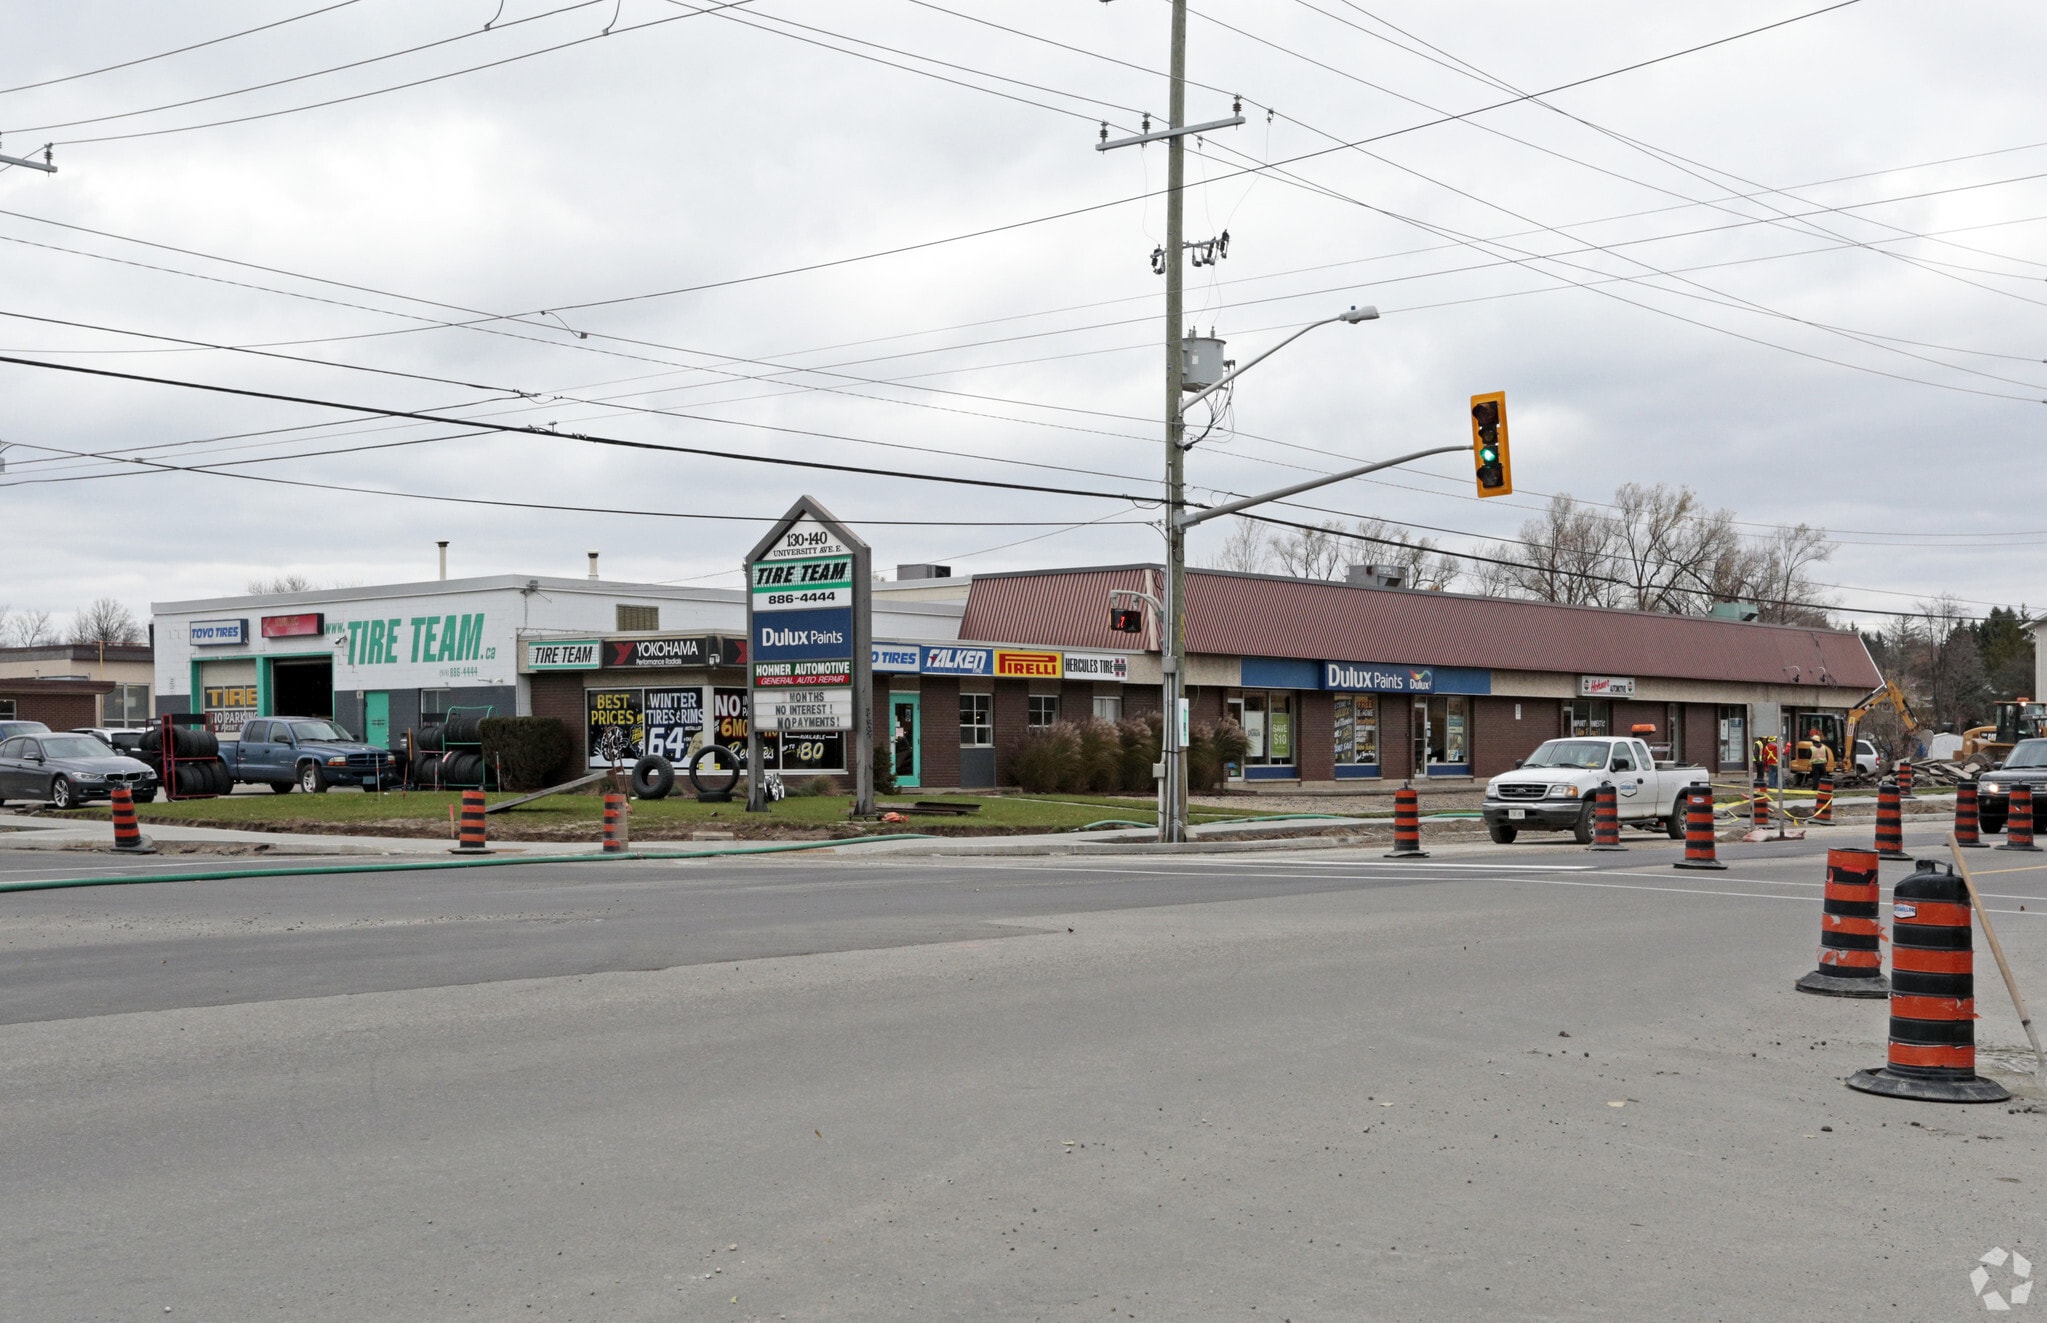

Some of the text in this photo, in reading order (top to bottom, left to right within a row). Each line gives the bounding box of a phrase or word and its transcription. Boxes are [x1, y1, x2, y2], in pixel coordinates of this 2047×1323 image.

[787, 531, 827, 547] 130-140
[773, 547, 817, 557] UNIVERSITY
[757, 562, 847, 585] TIRE TEAM
[768, 592, 835, 604] 886-4444
[191, 626, 239, 638] TOYO TIRES
[762, 628, 843, 647] Dulux Paints
[534, 646, 593, 664] TIRE TEAM
[636, 640, 699, 657] YOKOHAMA
[882, 651, 916, 665] TIRES
[999, 653, 1057, 675] PIRELLI
[1065, 657, 1114, 674] HERCULES TIRE
[756, 661, 850, 676] HOHNER AUTOMOTIVE
[761, 675, 845, 685] GENERAL AUTO REPAIR
[1328, 664, 1403, 689] Dulux Paints
[1410, 679, 1430, 690] Dulux
[597, 694, 630, 709] BEST
[650, 692, 697, 708] WINTER
[789, 692, 825, 702] MONTHS
[714, 695, 741, 717] NO
[775, 705, 787, 715] NO
[789, 704, 827, 714] INTEREST
[591, 710, 634, 725] PRICES
[646, 709, 675, 725] TIRES
[681, 709, 704, 724] RIMS
[777, 718, 791, 729] NO
[721, 718, 733, 737] 6
[1273, 724, 1287, 732] SAVE
[648, 727, 685, 758] 64
